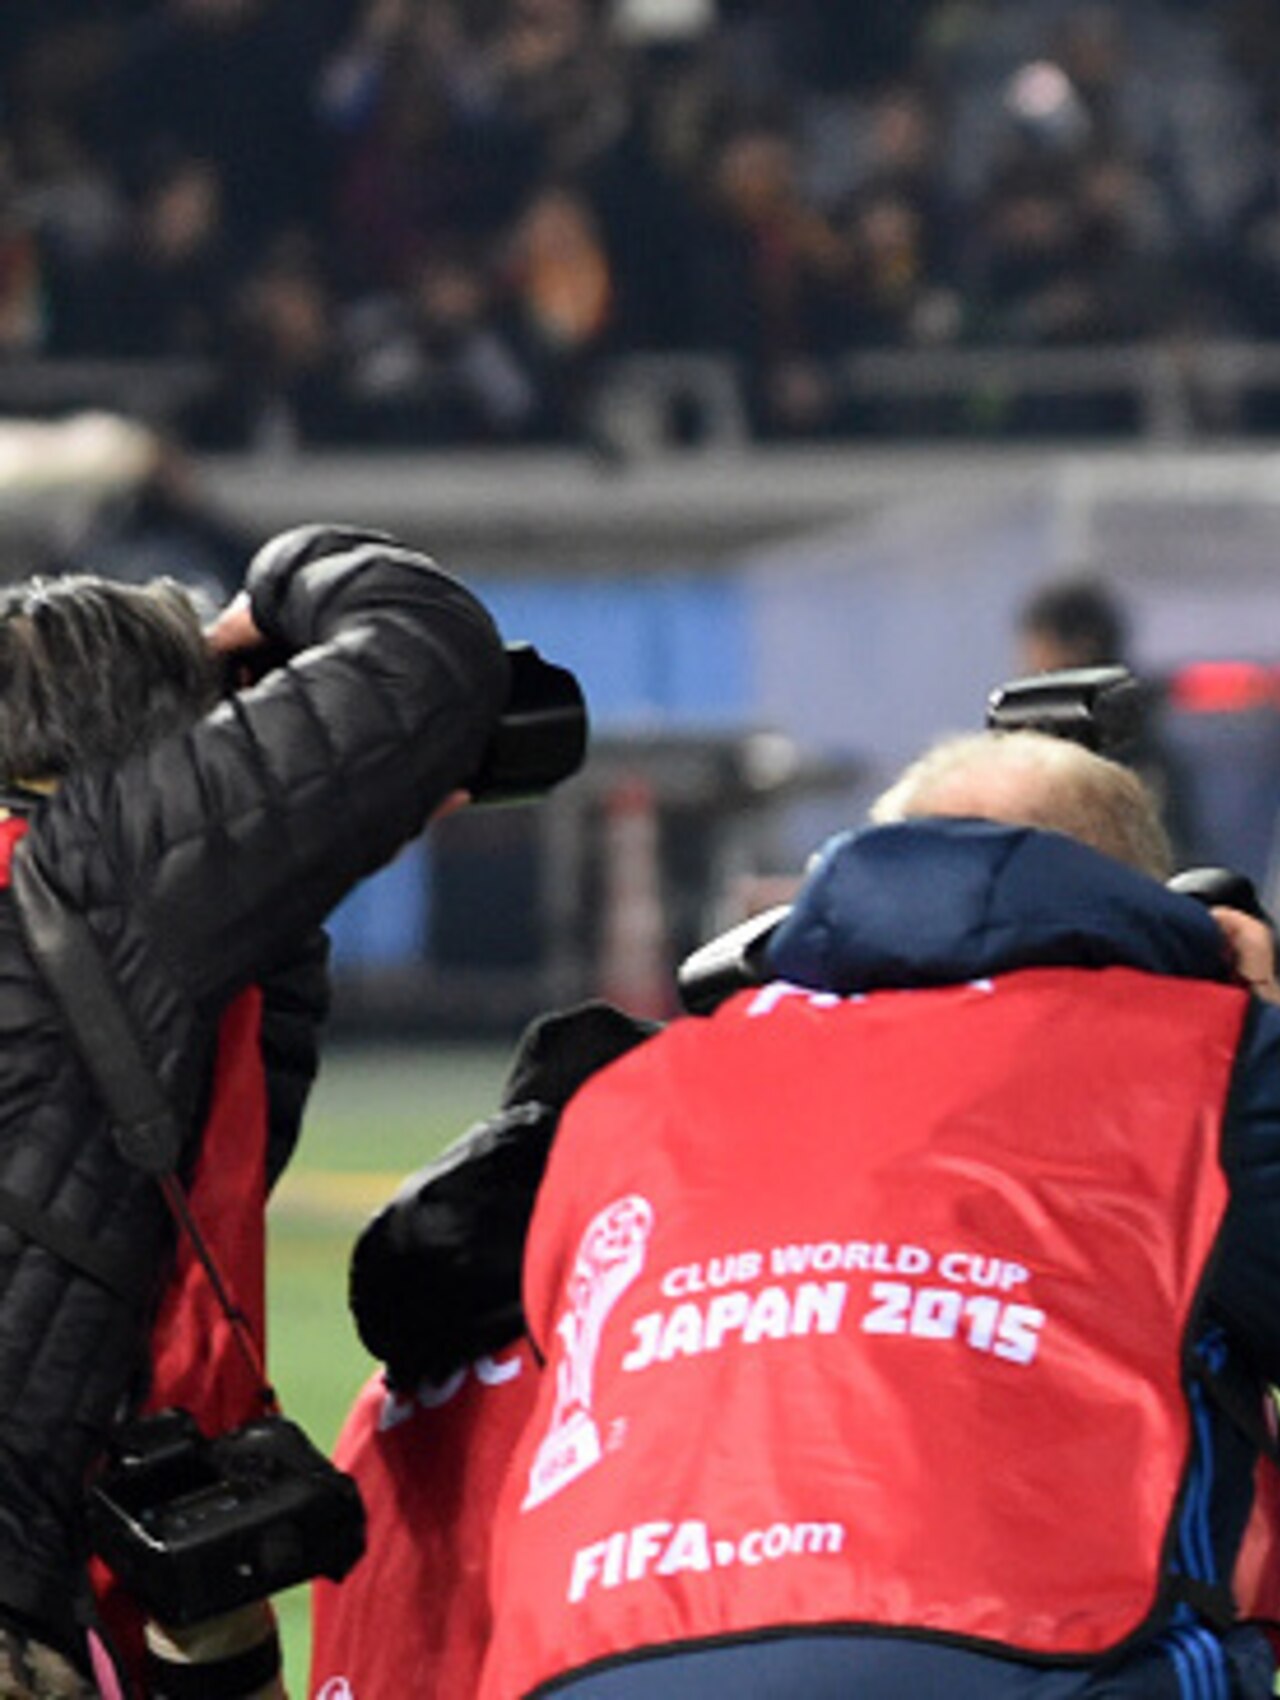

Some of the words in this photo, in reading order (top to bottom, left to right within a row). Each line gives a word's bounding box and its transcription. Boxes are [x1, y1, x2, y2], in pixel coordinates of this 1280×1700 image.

[663, 1252, 761, 1296] CLUB
[771, 1242, 930, 1275] WORLD
[939, 1253, 1030, 1291] CUP
[622, 1282, 848, 1371] JAPAN
[861, 1282, 1045, 1364] 2015
[567, 1519, 845, 1602] FIFA.com
